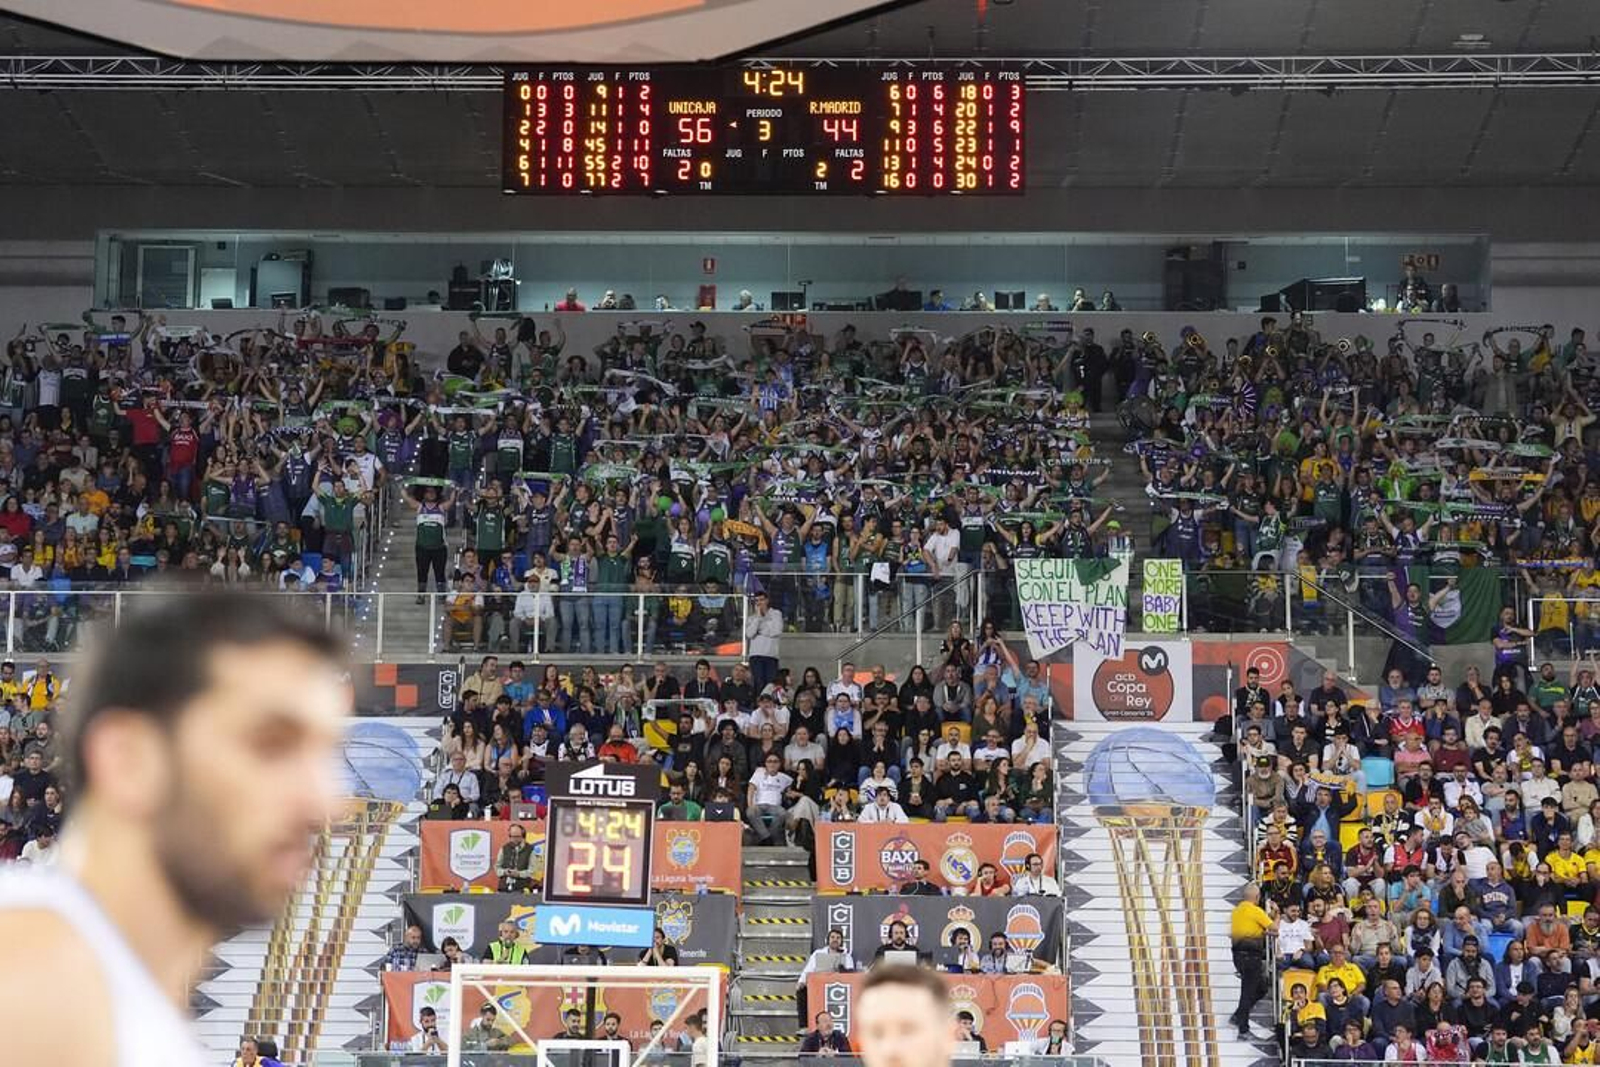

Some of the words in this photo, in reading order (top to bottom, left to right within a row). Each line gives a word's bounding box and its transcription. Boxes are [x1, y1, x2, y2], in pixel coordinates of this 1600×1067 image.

[512, 72, 529, 80] JUG
[539, 72, 544, 80] F
[553, 72, 574, 80] PTOS
[588, 72, 605, 80] JUG
[615, 72, 621, 80] F
[629, 72, 651, 80] PTOS
[744, 70, 804, 96] 4:24
[881, 72, 898, 80] JUG
[908, 72, 914, 80] F
[922, 72, 944, 80] PTOS
[958, 72, 975, 80] JUG
[985, 72, 991, 80] F
[999, 72, 1020, 80] PTOS
[520, 84, 531, 100] 0
[536, 85, 547, 100] 0
[563, 85, 574, 100] 0
[596, 84, 607, 99] 9
[618, 86, 623, 99] 1
[640, 85, 650, 100] 2
[889, 84, 901, 100] 6
[906, 84, 916, 100] 0
[933, 85, 944, 100] 6
[960, 84, 977, 101] 18
[982, 84, 993, 100] 0
[1012, 84, 1020, 100] 3
[525, 104, 531, 116] 1
[538, 102, 546, 118] 3
[565, 102, 574, 118] 3
[590, 103, 607, 116] 11
[618, 104, 623, 116] 1
[639, 104, 650, 116] 4
[669, 102, 716, 114] UNICAJA
[746, 109, 782, 118] PERIODO
[810, 102, 861, 114] R.MADRID
[891, 101, 900, 116] 7
[912, 104, 916, 116] 1
[933, 104, 943, 116] 4
[955, 101, 977, 118] 20
[988, 104, 993, 116] 1
[1010, 102, 1020, 117] 2
[519, 119, 531, 136] 2
[536, 120, 546, 135] 2
[563, 120, 573, 135] 0
[590, 121, 607, 134] 14
[618, 122, 623, 134] 1
[639, 120, 650, 135] 0
[679, 118, 711, 143] 56
[759, 121, 770, 141] 3
[824, 119, 857, 141] 44
[889, 119, 900, 134] 9
[908, 120, 916, 135] 3
[933, 120, 943, 135] 6
[955, 119, 977, 136] 22
[988, 122, 993, 134] 1
[1010, 119, 1020, 133] 9
[519, 138, 530, 151] 4
[541, 139, 546, 151] 1
[563, 137, 573, 153] 8
[584, 137, 606, 153] 45
[617, 139, 622, 151] 1
[634, 139, 649, 151] 11
[884, 138, 900, 152] 11
[906, 137, 916, 153] 0
[933, 137, 943, 153] 5
[955, 137, 977, 153] 23
[988, 139, 993, 151] 1
[1015, 139, 1020, 151] 1
[663, 149, 692, 158] FALTAS
[726, 149, 743, 158] JUG
[762, 149, 768, 158] F
[783, 149, 804, 158] PTOS
[835, 149, 864, 158] FALTAS
[518, 154, 530, 171] 6
[541, 156, 546, 168] 1
[557, 156, 573, 169] 11
[584, 154, 606, 171] 55
[611, 155, 622, 170] 2
[633, 155, 649, 170] 10
[678, 160, 690, 180] 2
[701, 162, 711, 178] 0
[817, 162, 827, 178] 2
[851, 160, 864, 180] 2
[884, 154, 900, 171] 13
[911, 157, 916, 169] 1
[933, 156, 943, 168] 4
[954, 154, 977, 171] 24
[982, 155, 993, 170] 0
[1010, 155, 1020, 170] 2
[520, 172, 530, 186] 7
[540, 174, 545, 186] 1
[562, 172, 573, 188] 0
[585, 172, 606, 187] 77
[611, 172, 622, 188] 2
[640, 172, 649, 186] 7
[700, 182, 712, 190] TM
[815, 182, 827, 190] TM
[884, 172, 900, 189] 16
[906, 172, 916, 188] 0
[933, 172, 943, 188] 0
[956, 172, 977, 189] 30
[988, 174, 993, 186] 1
[1010, 172, 1020, 188] 2
[1018, 559, 1111, 581] SEGUI
[1146, 561, 1181, 578] ONE
[1019, 582, 1053, 602] CON
[1057, 582, 1080, 602] EL
[1085, 583, 1130, 607] PLAN
[1143, 579, 1181, 595] MORE
[1144, 595, 1180, 613] BABY
[1022, 604, 1074, 628] KEEP
[1078, 605, 1126, 632] WITH
[1145, 613, 1179, 630] ONE
[1032, 628, 1074, 649] THE
[1115, 672, 1136, 681] acb
[1107, 681, 1146, 694] Copa
[1127, 695, 1152, 709] Rey
[569, 779, 636, 797] LOTUS
[578, 811, 641, 837] 4:24
[835, 835, 851, 881] CJB
[882, 851, 919, 863] BAXI
[566, 842, 631, 893] 24
[661, 875, 686, 884] Laguna
[688, 874, 715, 882] Tenerife
[588, 920, 640, 934] Movistar
